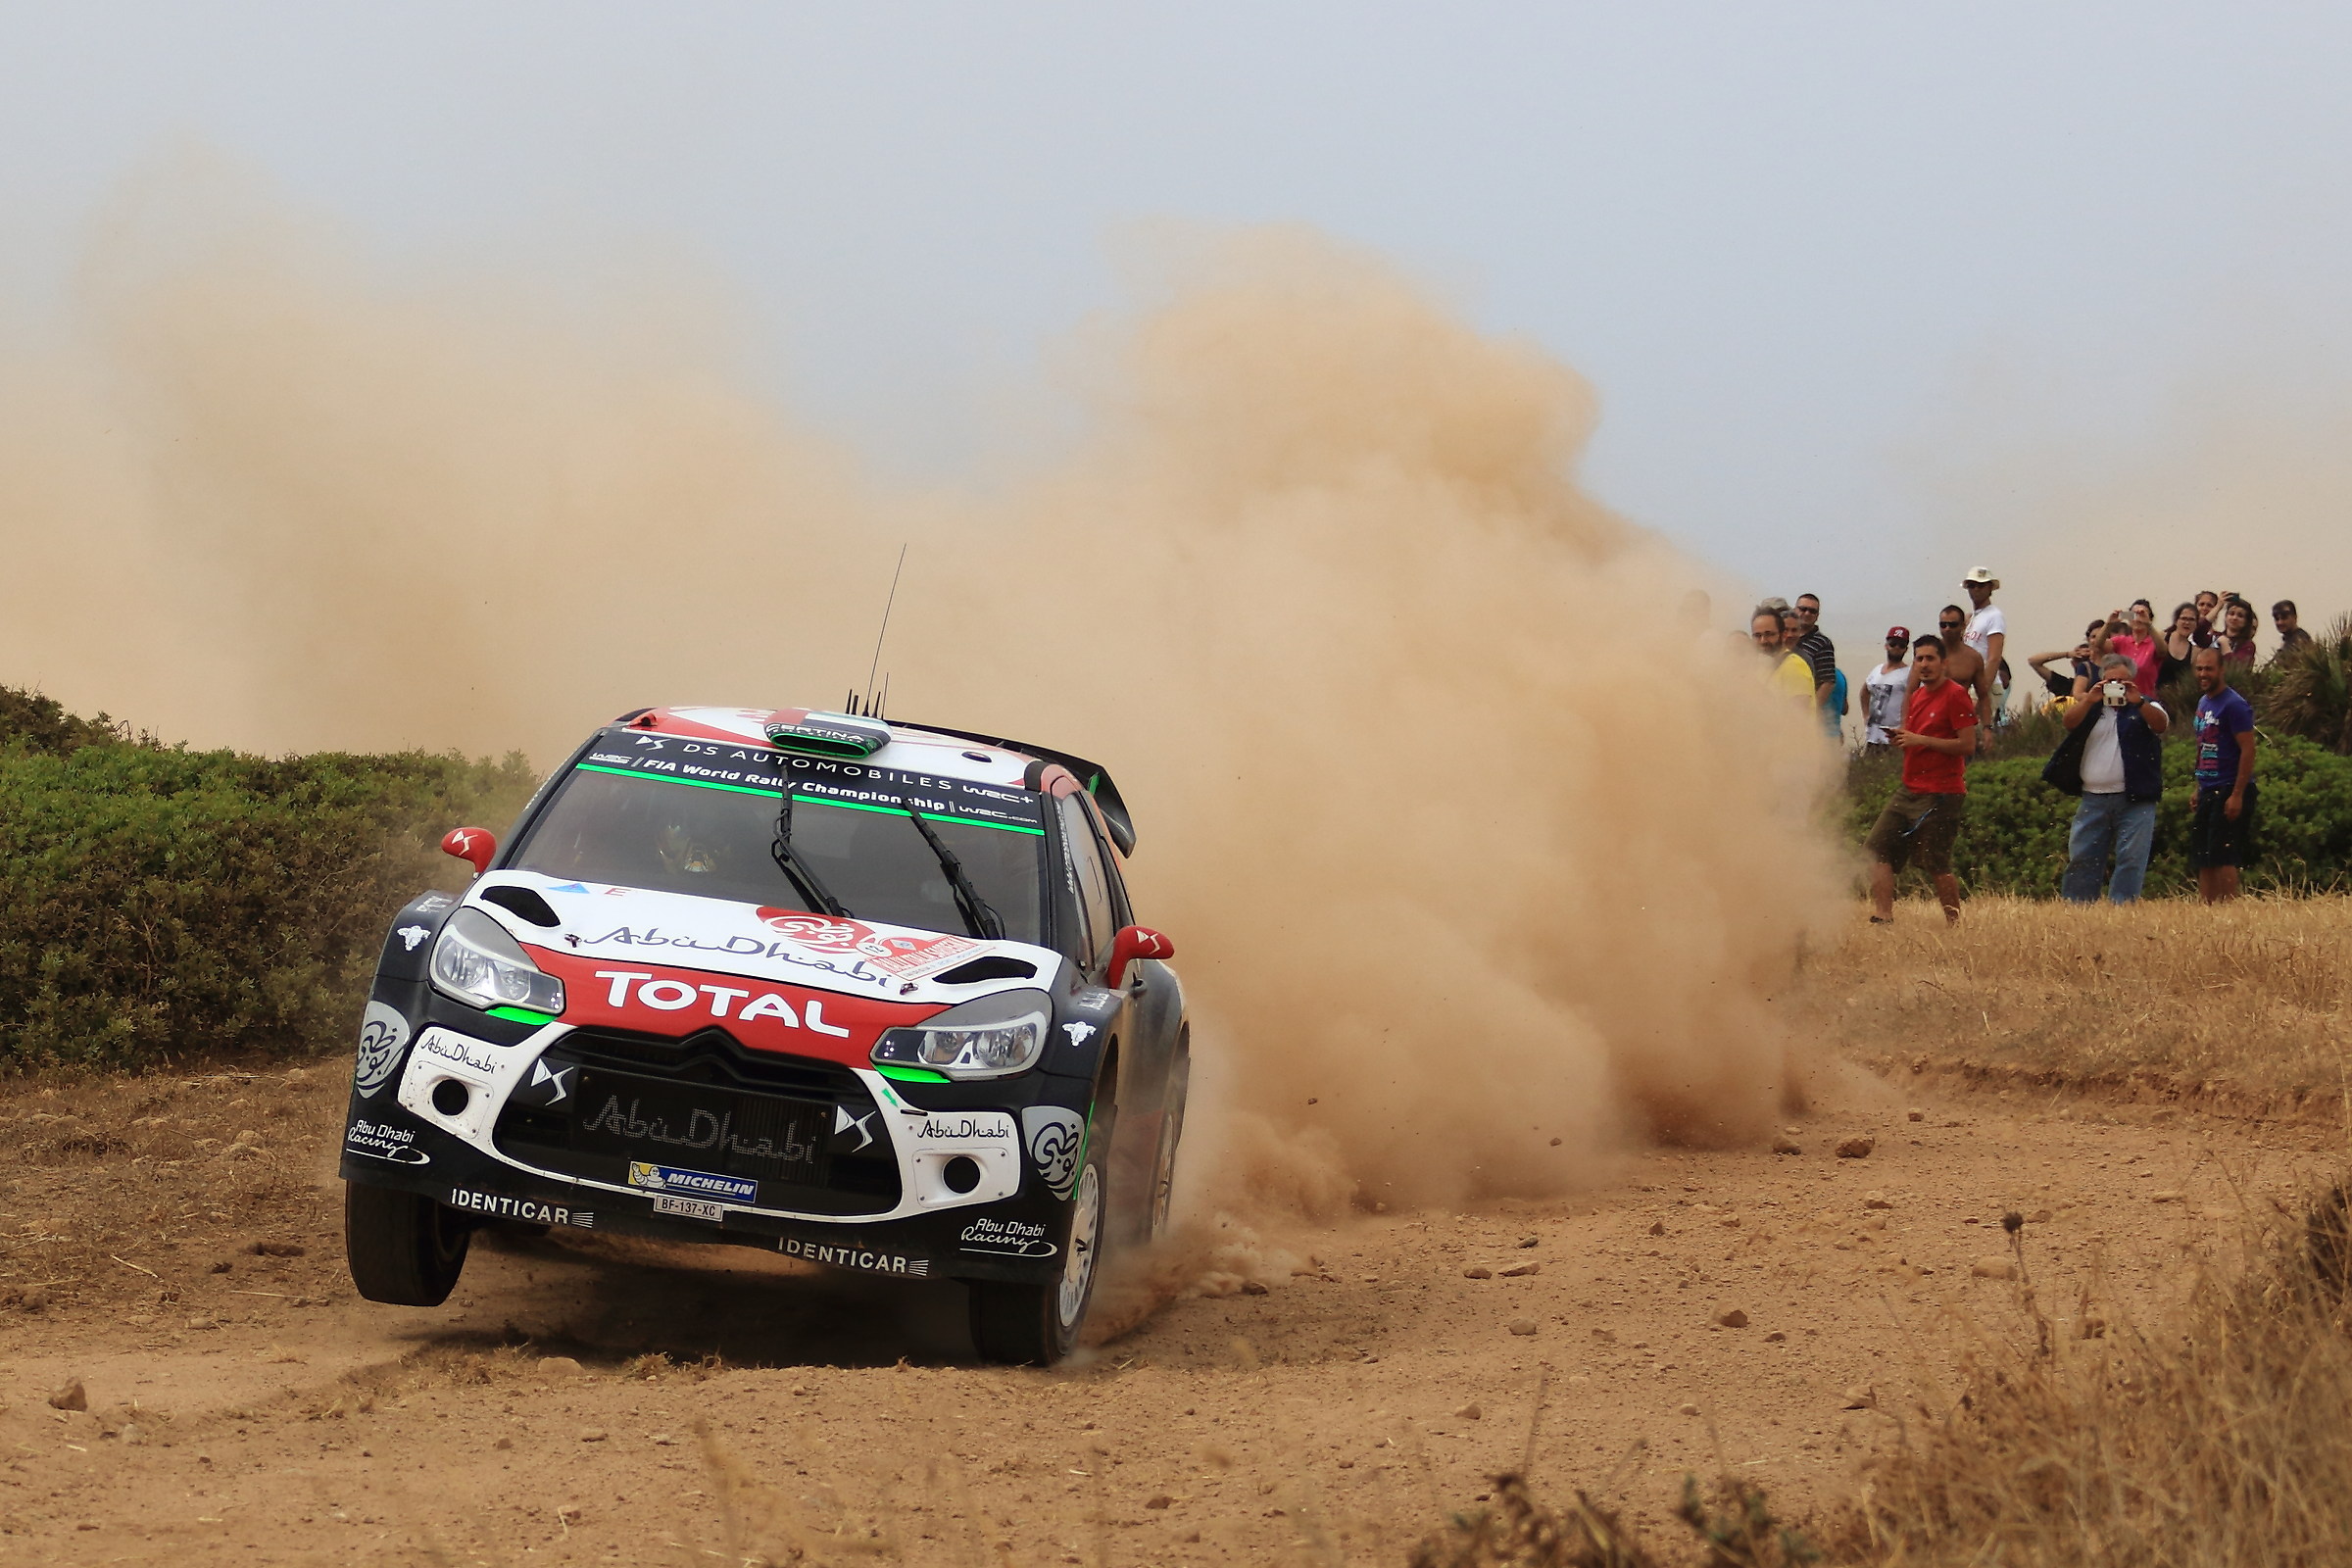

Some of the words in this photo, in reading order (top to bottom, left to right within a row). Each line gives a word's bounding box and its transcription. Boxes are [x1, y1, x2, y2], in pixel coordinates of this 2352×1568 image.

[682, 743, 719, 756] DS
[729, 750, 952, 790] AUTOMOBILES
[643, 759, 676, 771] FIA
[683, 763, 741, 781] World
[802, 782, 945, 811] Championhip
[594, 970, 851, 1039] TOTAL
[348, 1127, 410, 1157] Racing
[356, 1119, 375, 1135] Abu
[376, 1124, 416, 1144] Dhabi
[666, 1172, 754, 1196] MICHELIN
[451, 1188, 569, 1224] IDENTICAR
[662, 1199, 715, 1216] BF-137-XC
[961, 1225, 1040, 1253] Racing
[975, 1218, 1004, 1233] Abu
[1005, 1221, 1046, 1237] Dhabi
[778, 1237, 906, 1273] IDENTICAR
